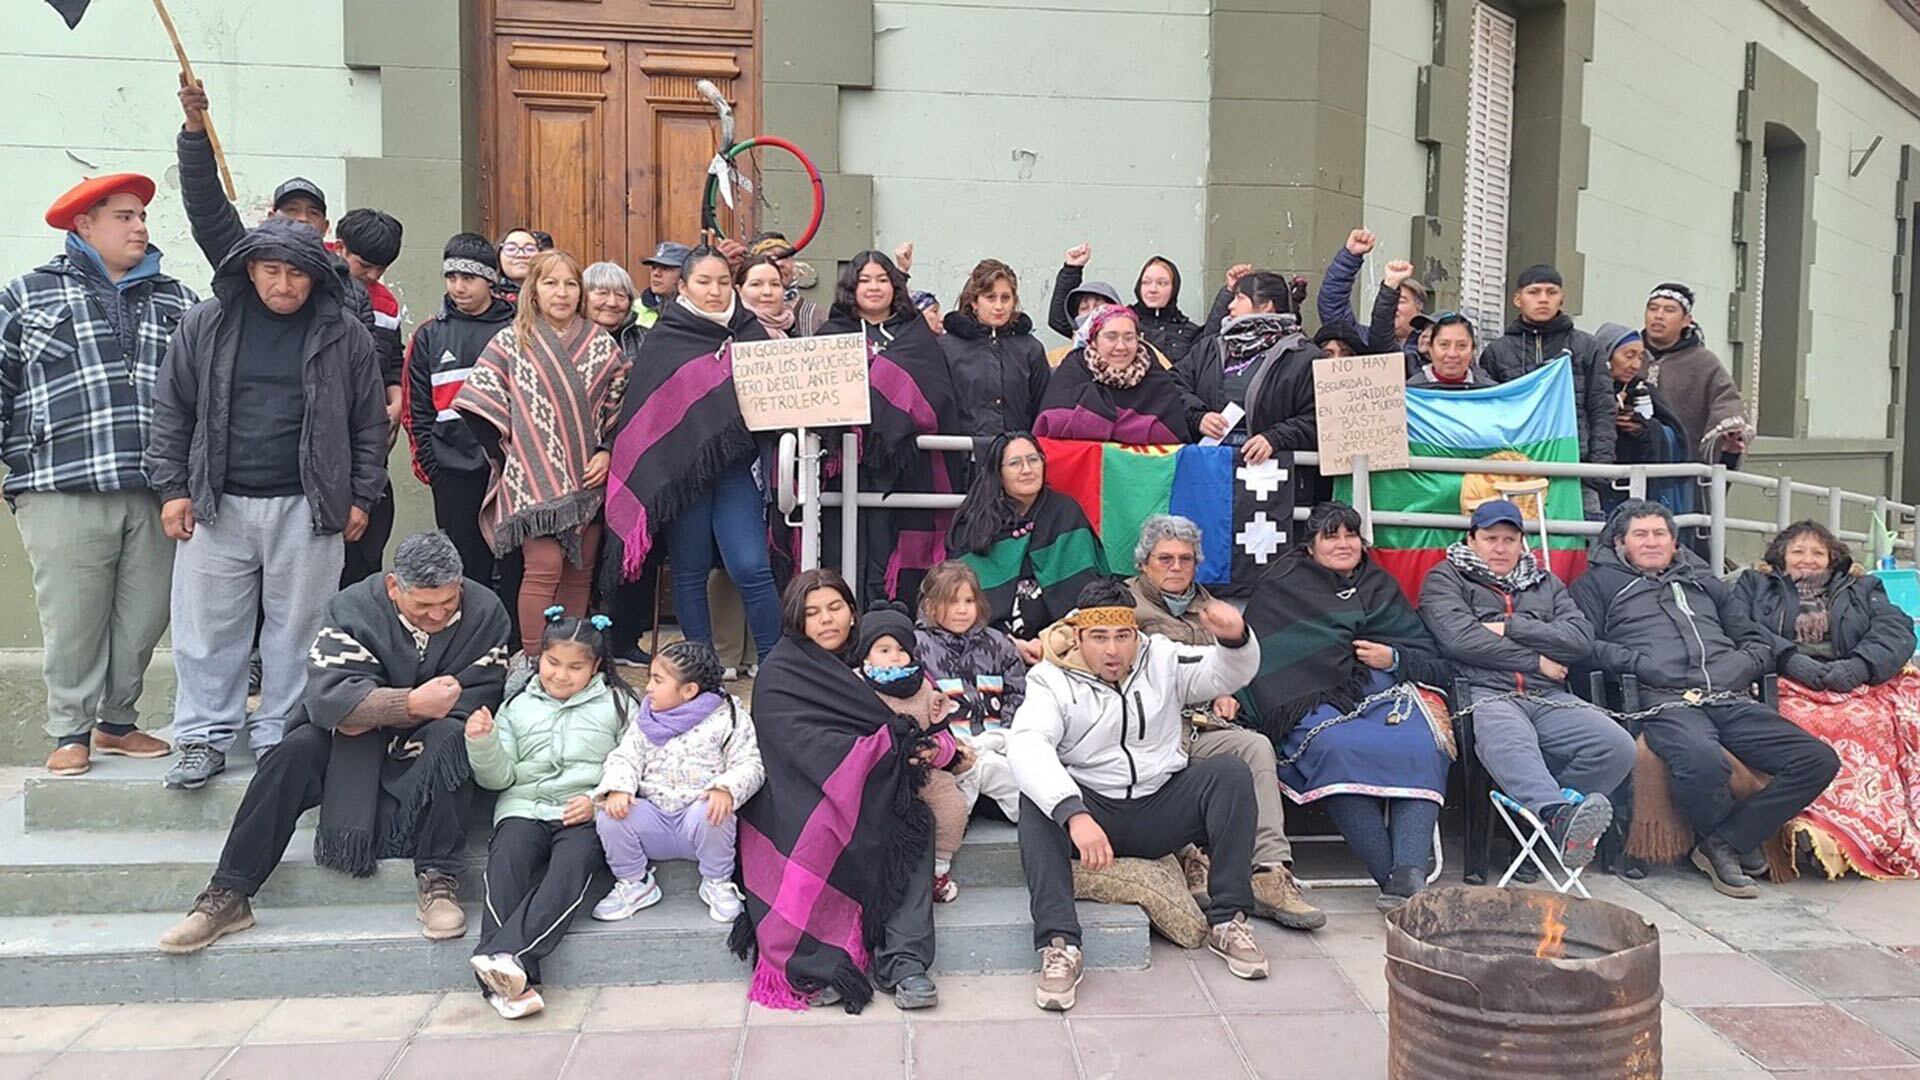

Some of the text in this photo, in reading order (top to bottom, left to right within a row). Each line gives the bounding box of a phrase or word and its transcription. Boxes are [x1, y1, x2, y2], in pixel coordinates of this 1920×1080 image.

[735, 335, 864, 360] UN GOBIERNO FUERTE
[735, 352, 860, 379] CONTRA LOS MAPUCHES
[1332, 357, 1388, 373] NO HAY
[736, 369, 865, 396] PERO DEBIL ANTE LAS
[1316, 377, 1372, 395] SEGURIDAD
[751, 390, 840, 413] PETROLERAS
[1347, 384, 1401, 402] JURIDICA
[1319, 406, 1332, 417] EN
[1339, 403, 1367, 415] VACA
[1337, 415, 1386, 429] BASTA
[1341, 425, 1404, 440] VIOLENTAR
[1337, 438, 1397, 453] DERECHOS
